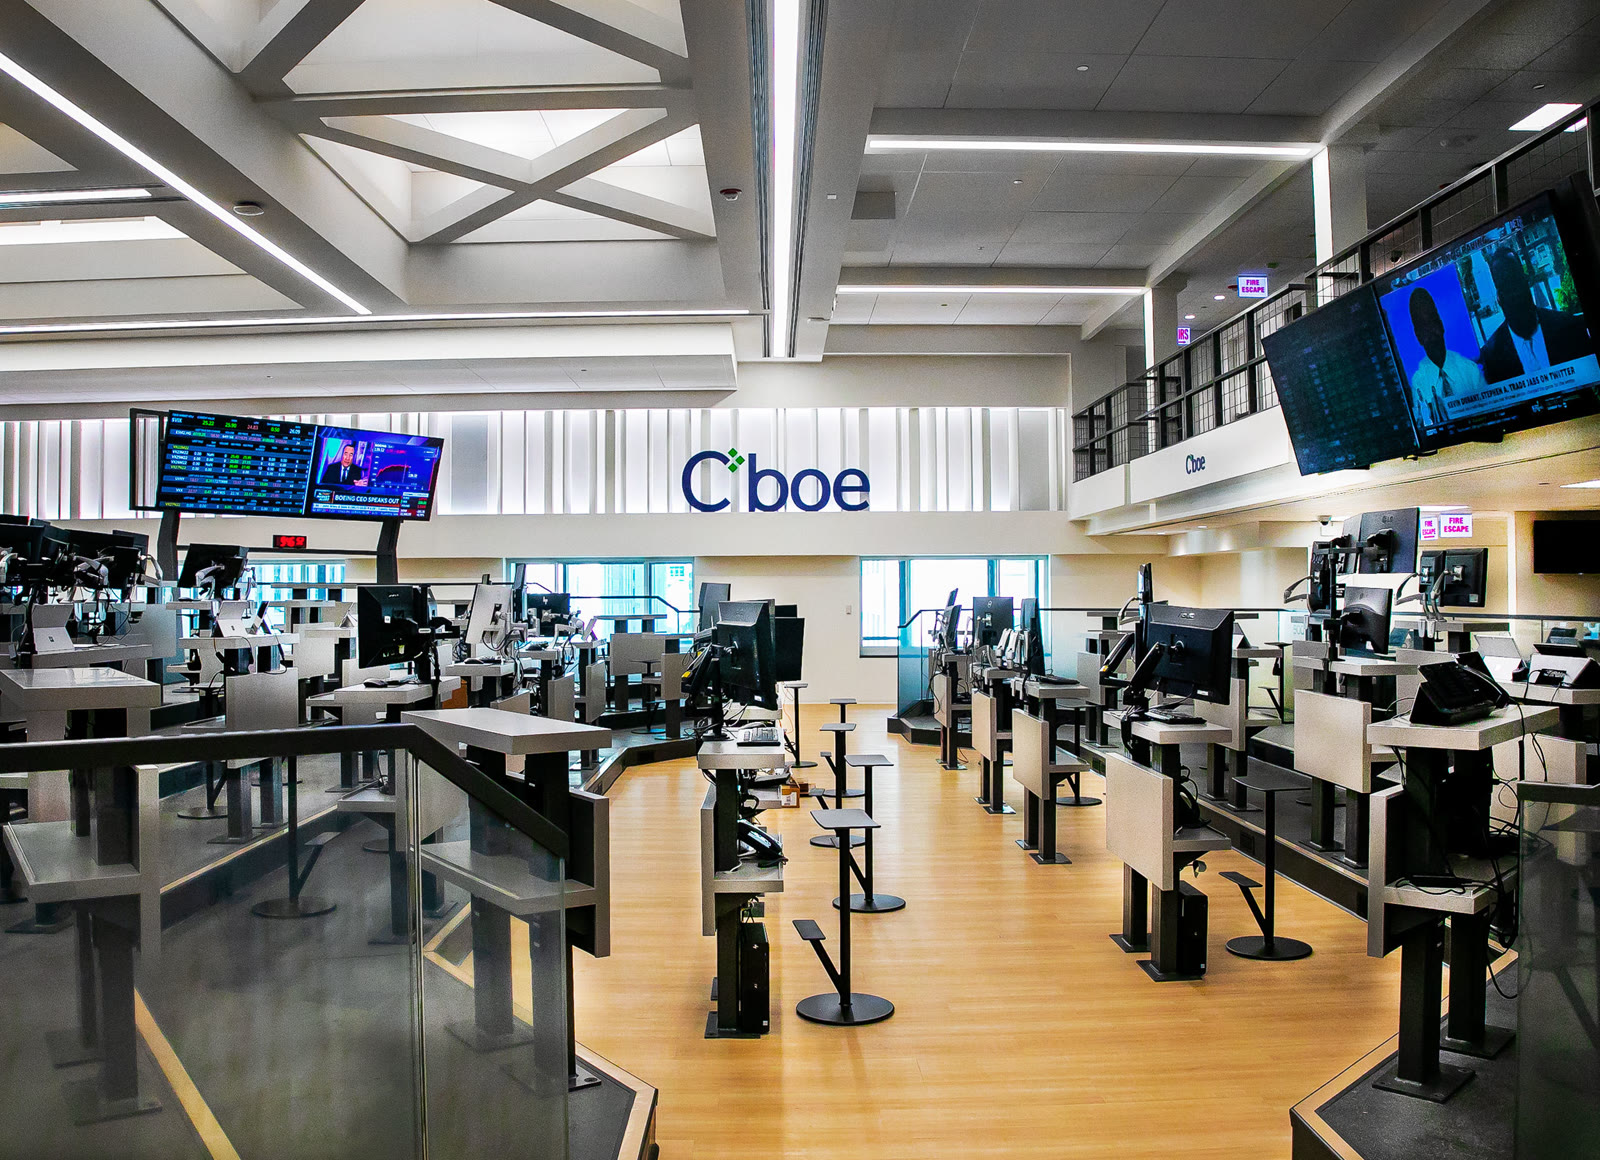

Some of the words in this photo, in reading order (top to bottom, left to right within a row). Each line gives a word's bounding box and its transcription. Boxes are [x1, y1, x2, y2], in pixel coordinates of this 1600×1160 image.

[1178, 329, 1189, 340] IRS
[1480, 387, 1503, 400] STEPHEN
[1509, 379, 1526, 391] TRADE
[1540, 374, 1549, 383] ON
[1549, 366, 1576, 381] TWITTER
[1185, 454, 1206, 475] Cboe
[681, 449, 871, 513] Cboe
[334, 494, 356, 502] BOEING
[368, 496, 388, 504] SPEAKS
[388, 497, 400, 505] OUT
[1443, 525, 1469, 533] ESCAPE
